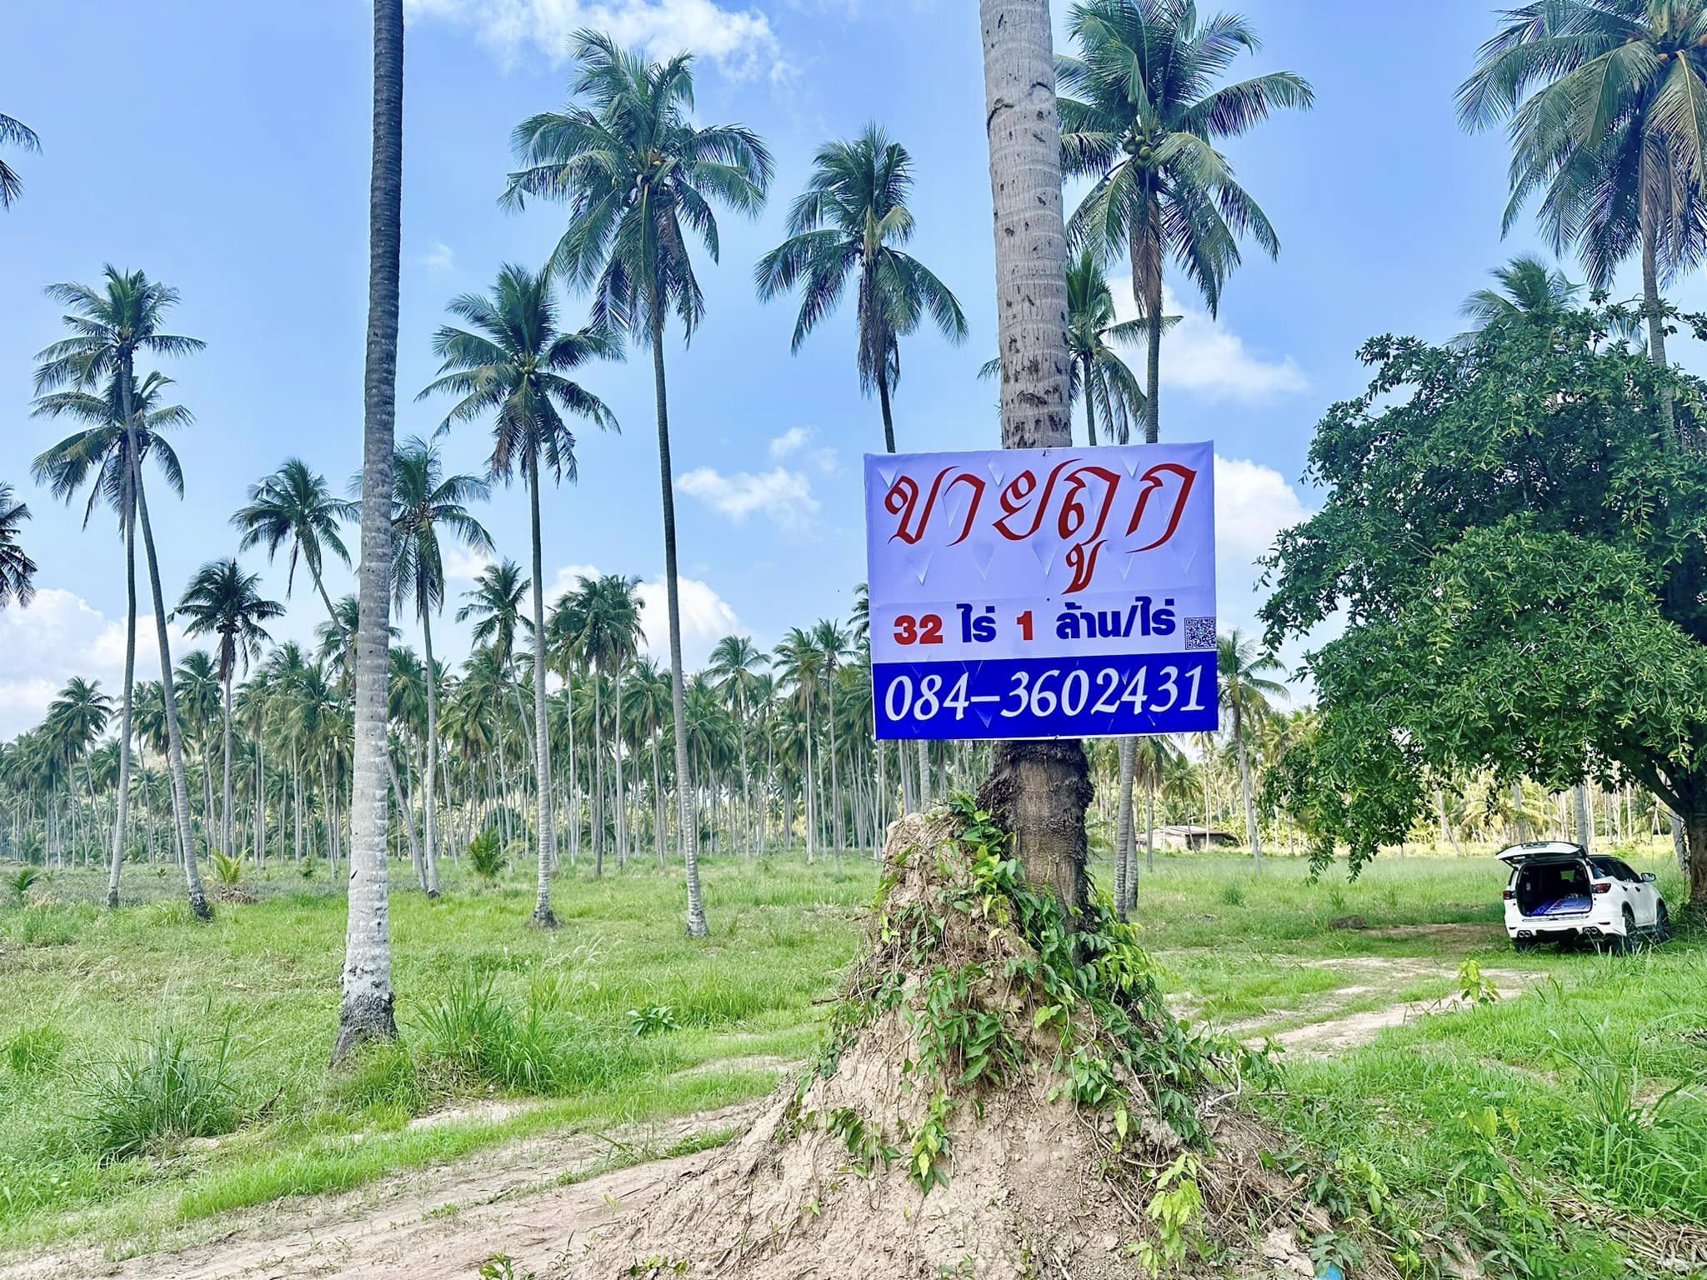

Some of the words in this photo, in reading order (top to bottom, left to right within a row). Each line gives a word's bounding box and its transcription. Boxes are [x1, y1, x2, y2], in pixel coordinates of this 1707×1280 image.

[884, 458, 1198, 595] ขายถูก
[893, 614, 944, 645] 32
[956, 603, 997, 643] ไร่
[1016, 611, 1034, 641] 1
[1055, 596, 1177, 640] ล้าน/ไร่
[884, 664, 1207, 722] 084-3602431
